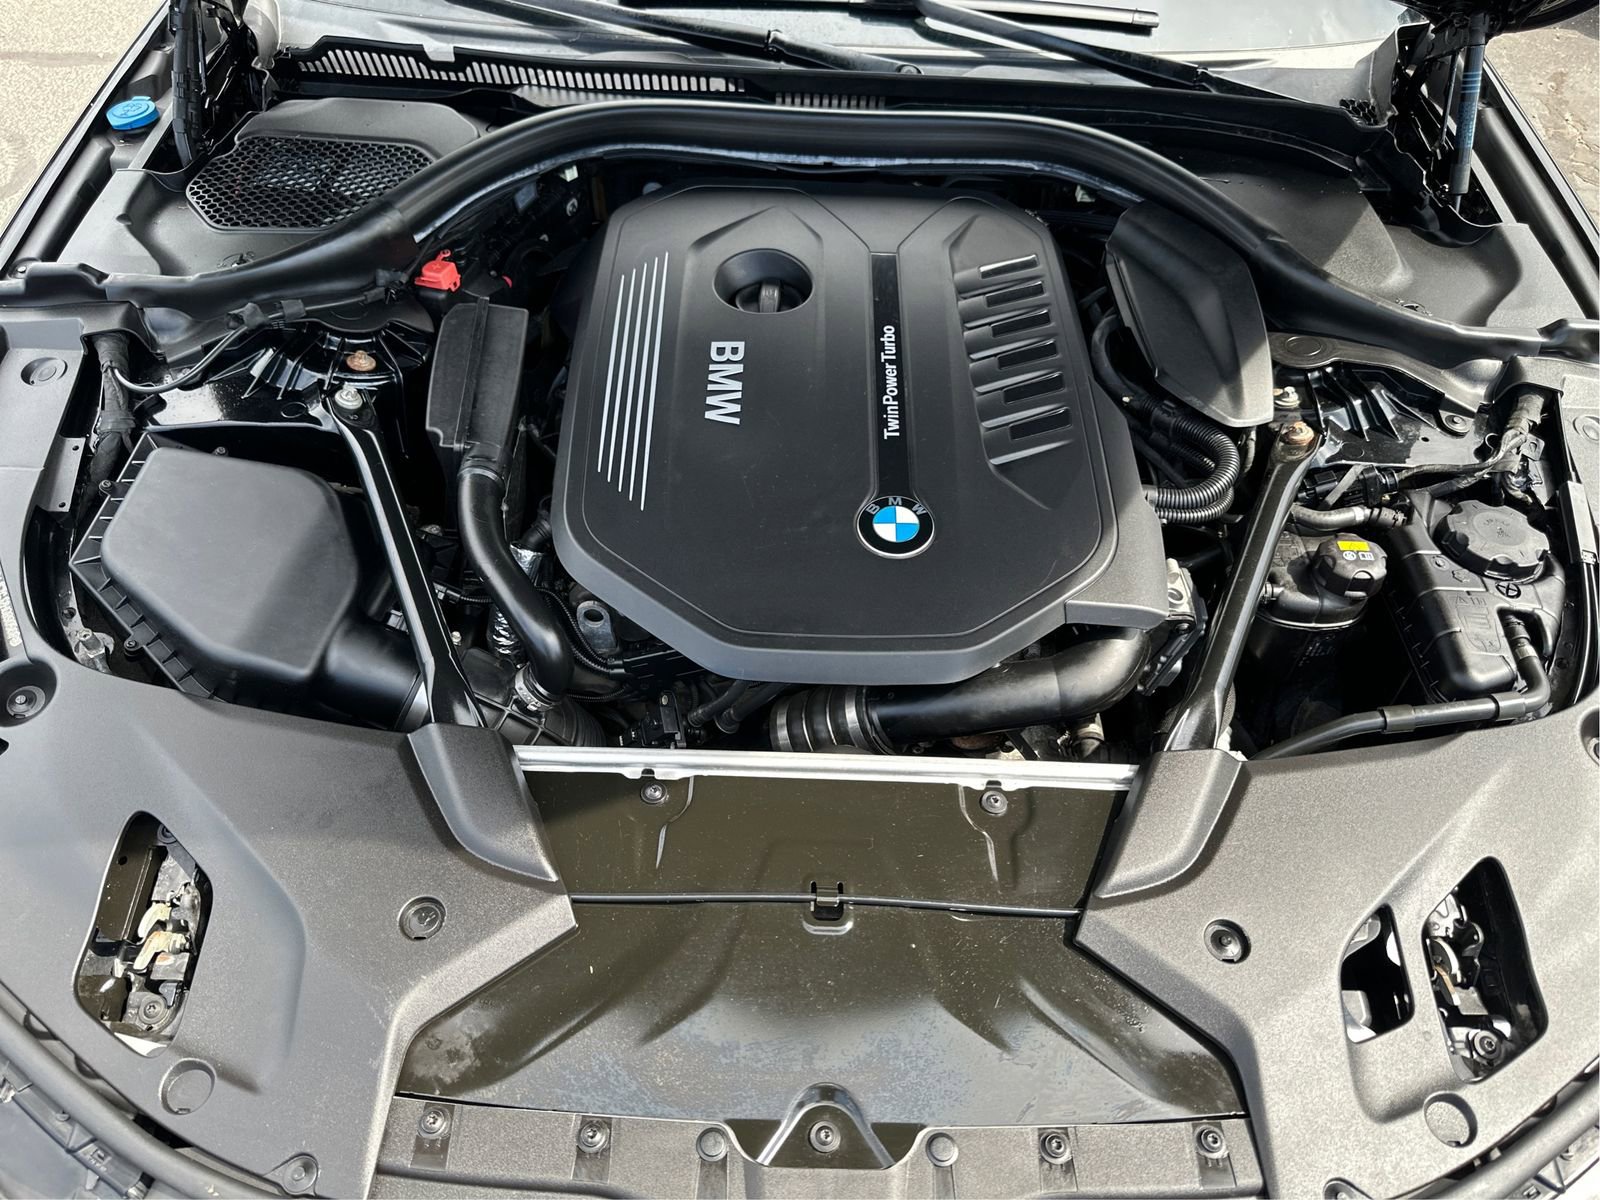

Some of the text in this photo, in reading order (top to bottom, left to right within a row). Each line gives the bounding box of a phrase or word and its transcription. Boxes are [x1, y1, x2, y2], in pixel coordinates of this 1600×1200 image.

[704, 340, 745, 425] BMW
[880, 325, 900, 440] TwinPower Turbo
[865, 497, 928, 516] BMW
